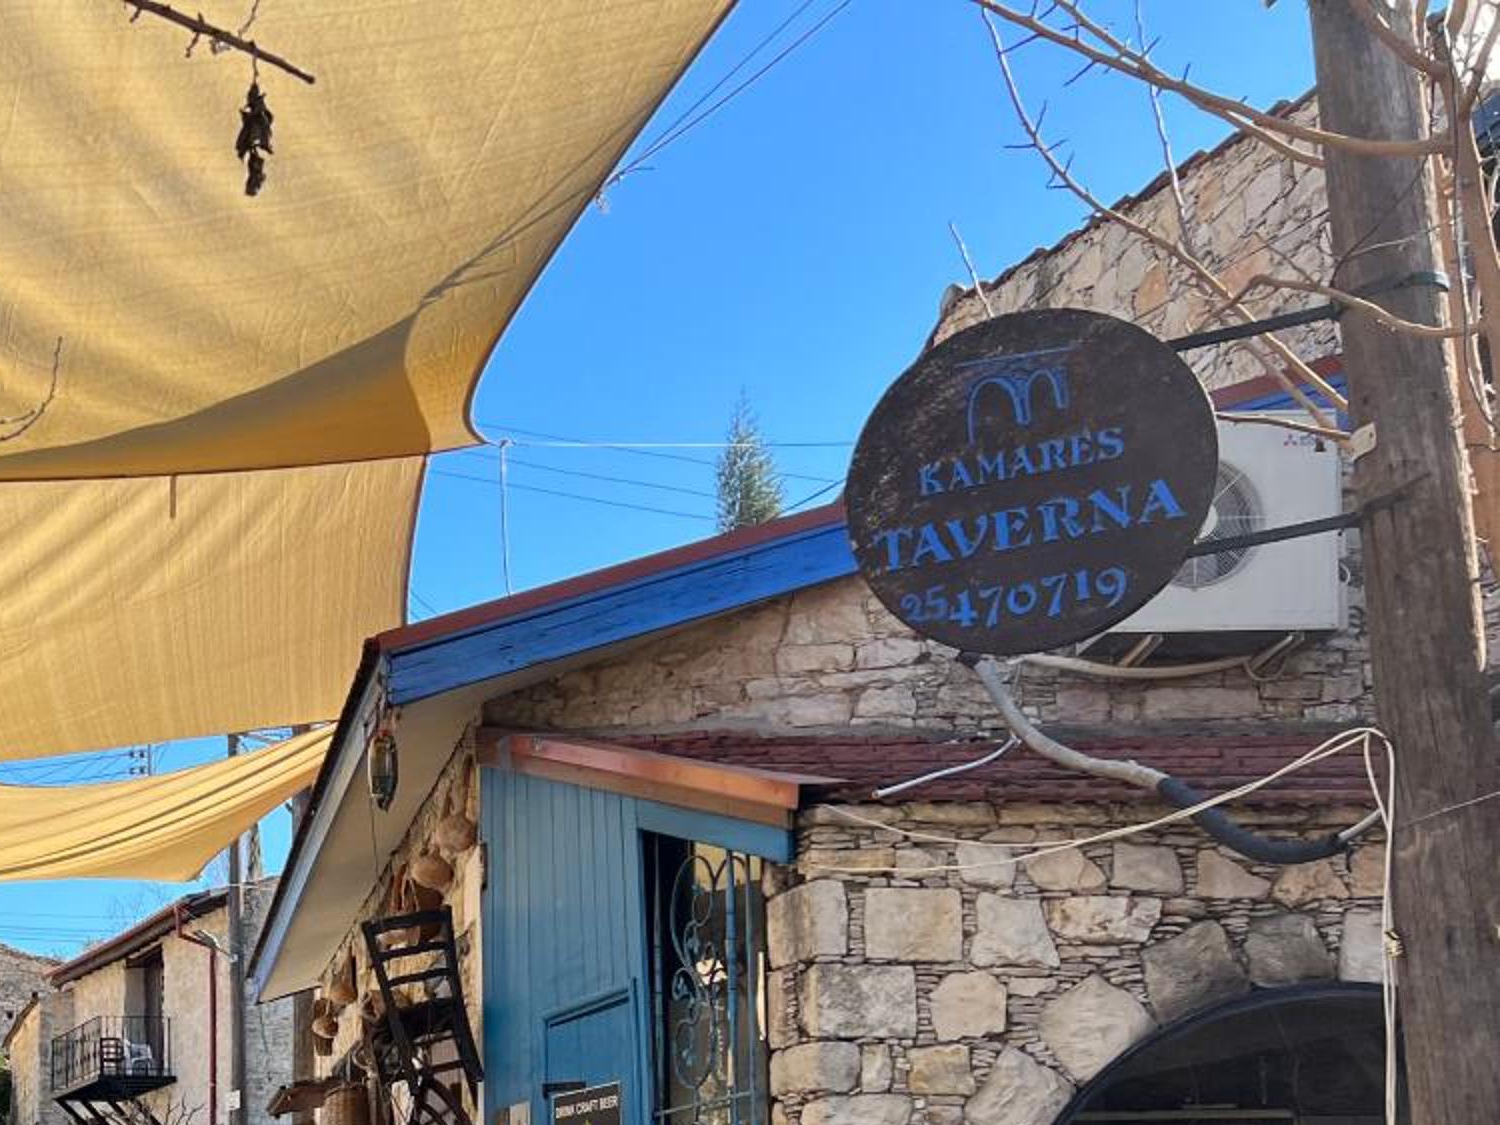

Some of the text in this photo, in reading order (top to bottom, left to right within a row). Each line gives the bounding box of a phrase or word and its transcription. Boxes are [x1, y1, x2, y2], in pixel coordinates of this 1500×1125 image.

[918, 425, 1126, 496] KAMARES
[872, 479, 1188, 572] TAVERNA
[902, 566, 1129, 629] 25470719
